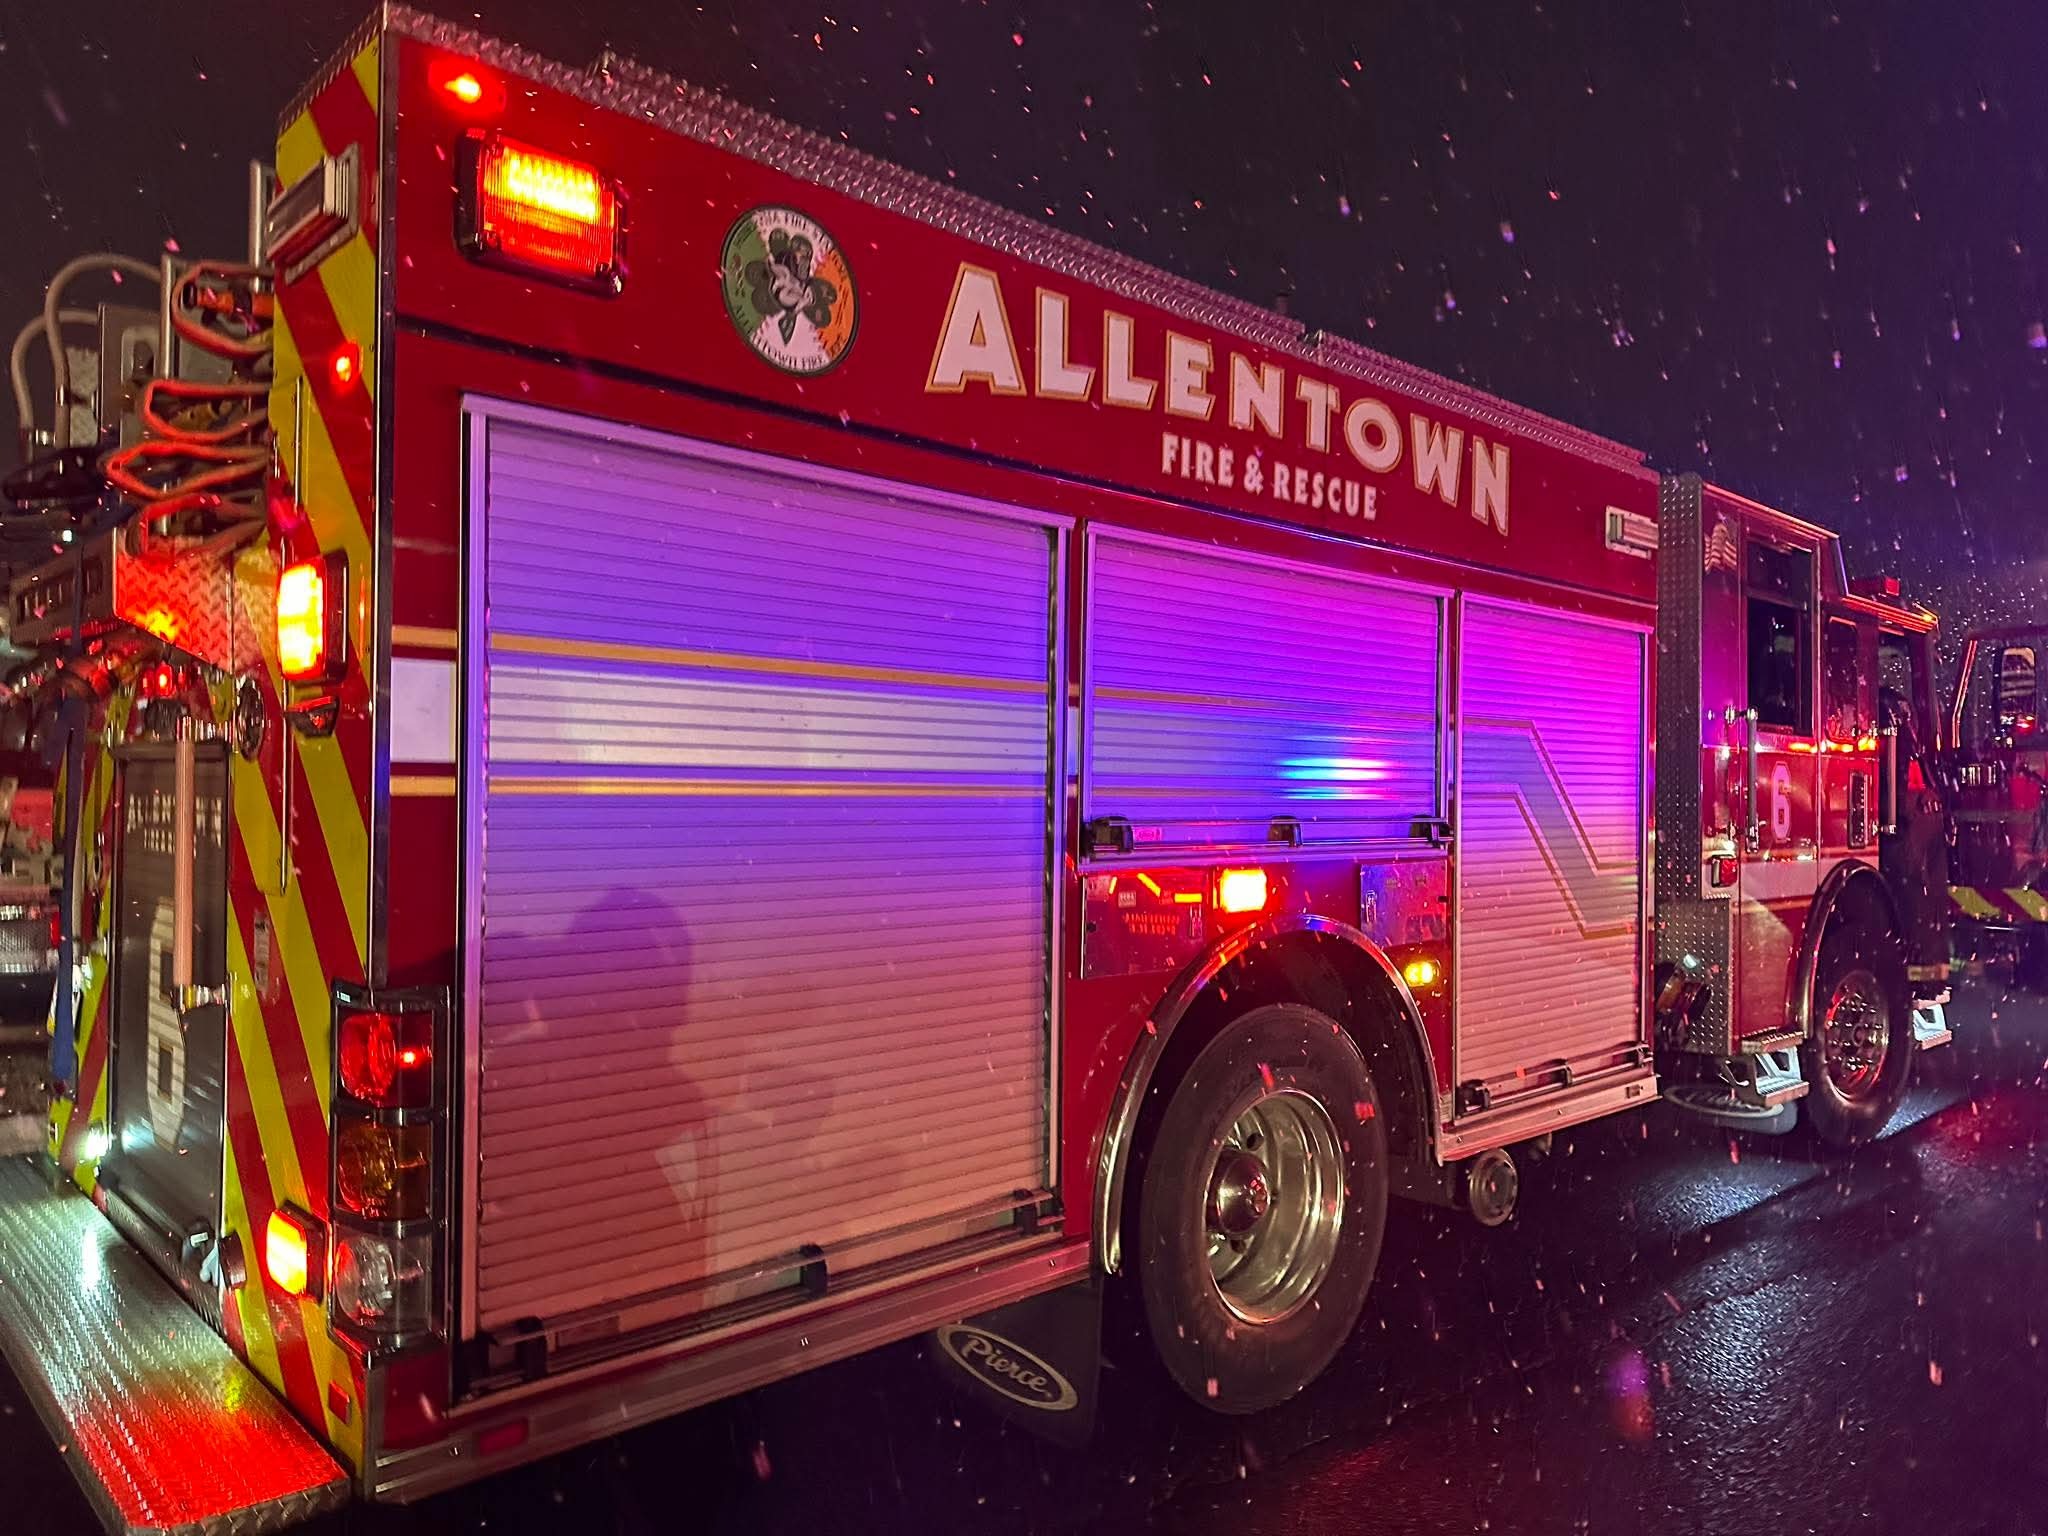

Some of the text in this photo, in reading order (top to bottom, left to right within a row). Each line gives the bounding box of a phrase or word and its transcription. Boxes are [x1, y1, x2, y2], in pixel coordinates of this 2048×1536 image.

[924, 262, 1510, 536] ALLENTOWN
[1161, 432, 1378, 521] FIRE & RESCUE
[1771, 761, 1792, 843] 6
[961, 1334, 1048, 1393] Pierce
